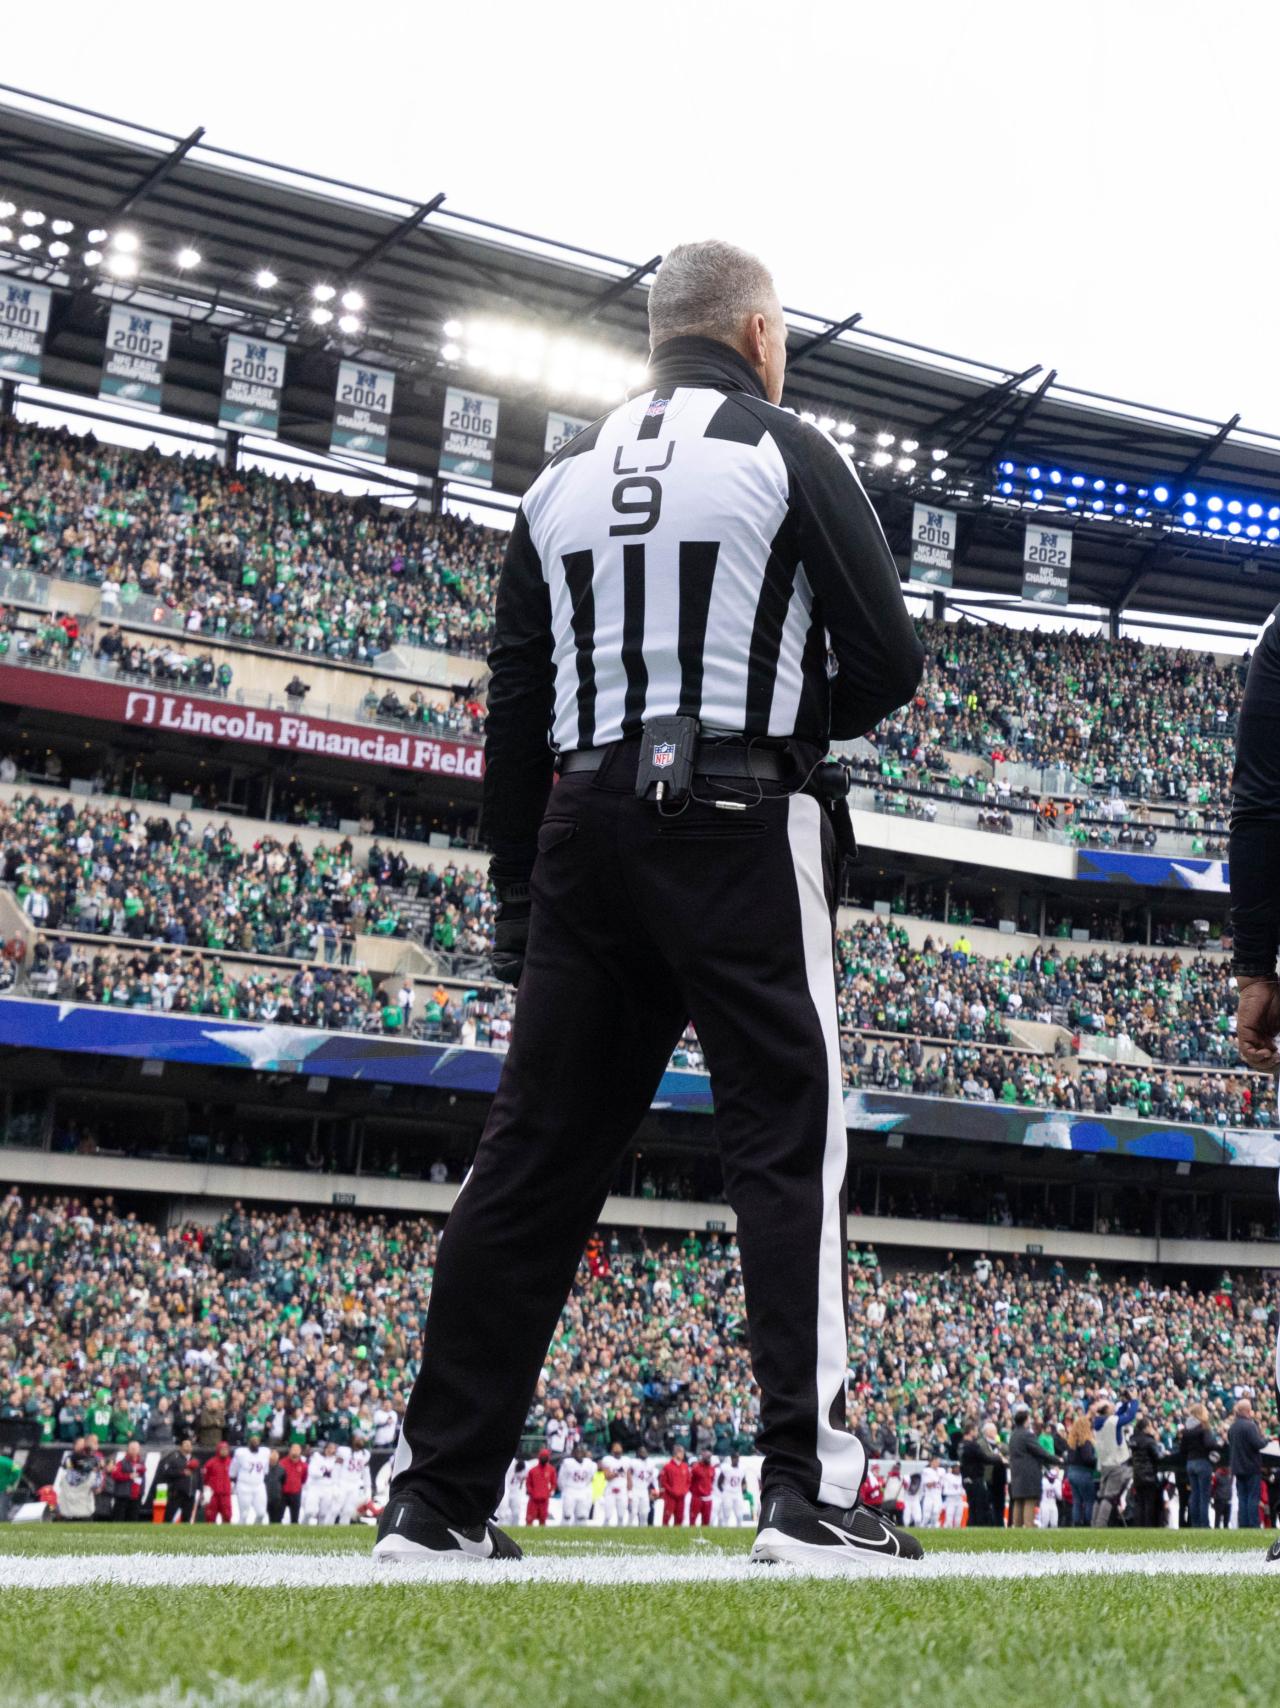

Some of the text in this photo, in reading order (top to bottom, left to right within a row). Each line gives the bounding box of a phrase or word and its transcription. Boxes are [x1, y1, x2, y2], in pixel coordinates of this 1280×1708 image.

[114, 330, 163, 358] 2002
[231, 358, 278, 384] 2003
[342, 385, 387, 410] 2004
[450, 411, 492, 435] 2006
[613, 440, 676, 475] LJ
[609, 476, 663, 537] 9
[918, 525, 951, 546] 2019
[1028, 546, 1067, 566] 2022
[1025, 573, 1068, 588] CHAMPIONS
[1039, 566, 1055, 578] NFC
[161, 699, 483, 778] Lincoln Financial Field
